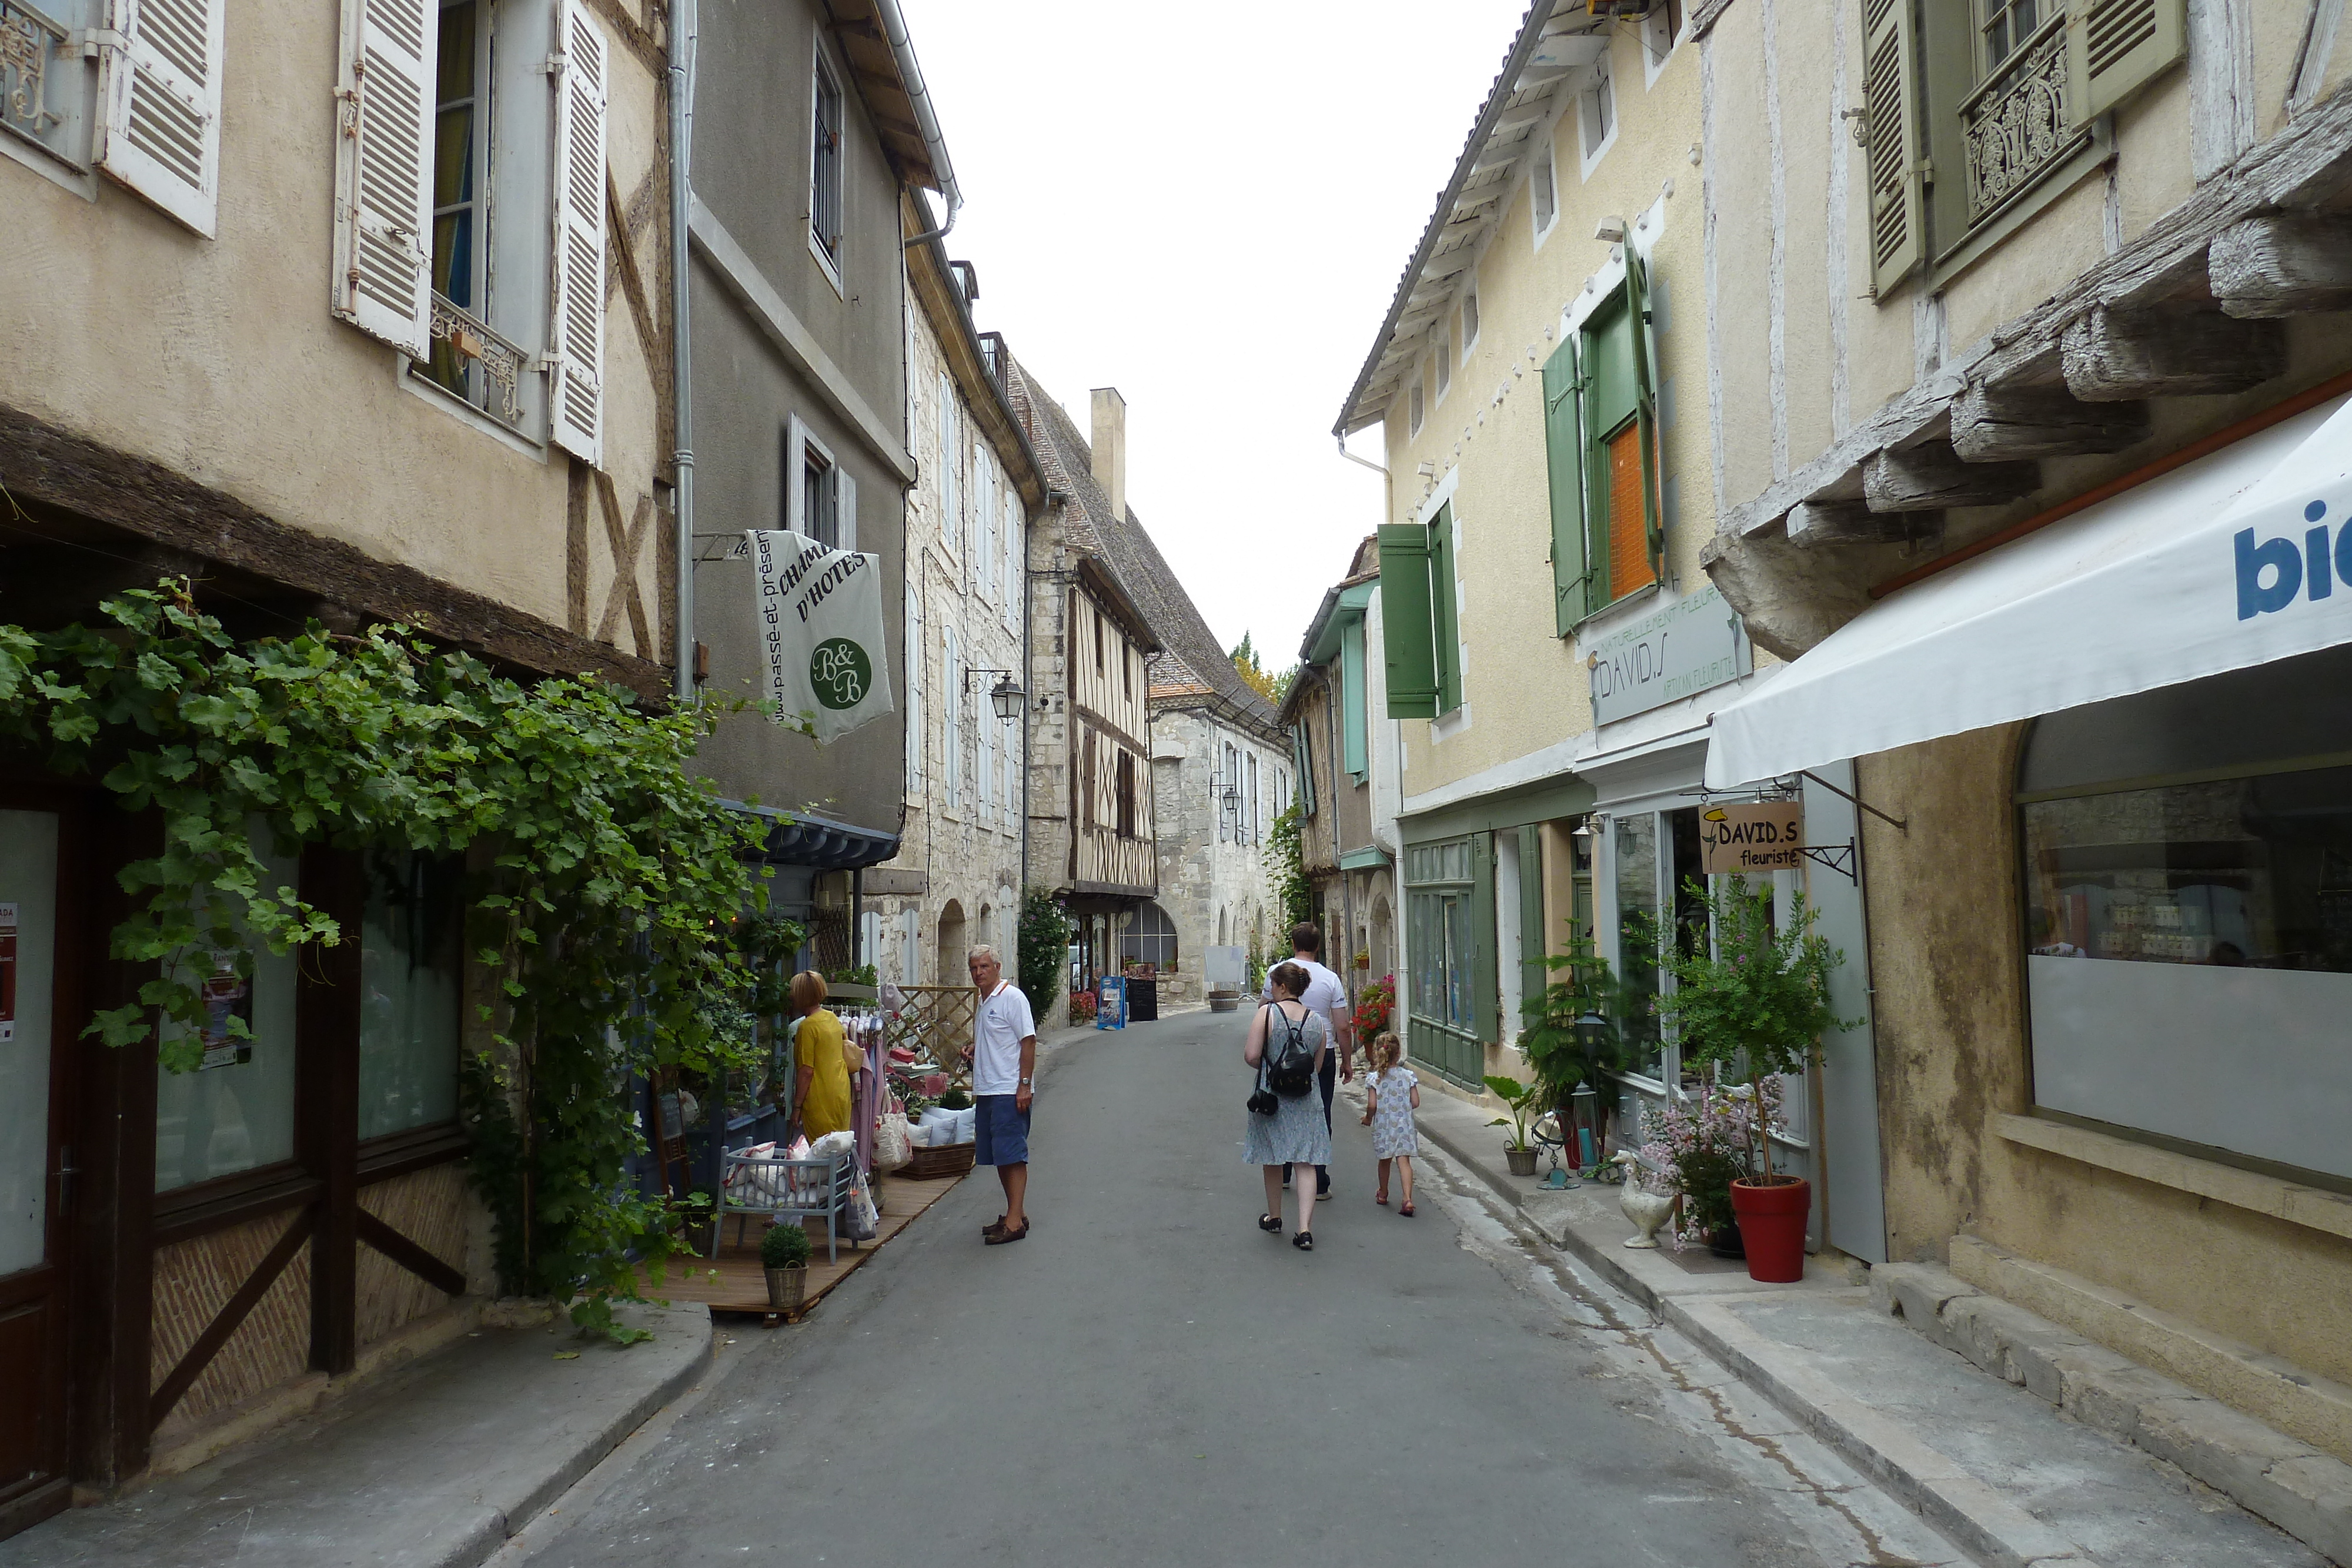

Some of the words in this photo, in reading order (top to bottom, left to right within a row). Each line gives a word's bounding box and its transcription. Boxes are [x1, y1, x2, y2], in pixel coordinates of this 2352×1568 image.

[796, 552, 866, 623] D'HOTES
[1601, 607, 1676, 653] NATURELLEMENT
[1663, 673, 1692, 699] ARTISAN
[1693, 656, 1735, 687] FLEURISTE
[1719, 821, 1798, 845] DAVID.S
[1740, 849, 1798, 867] fleuriste
